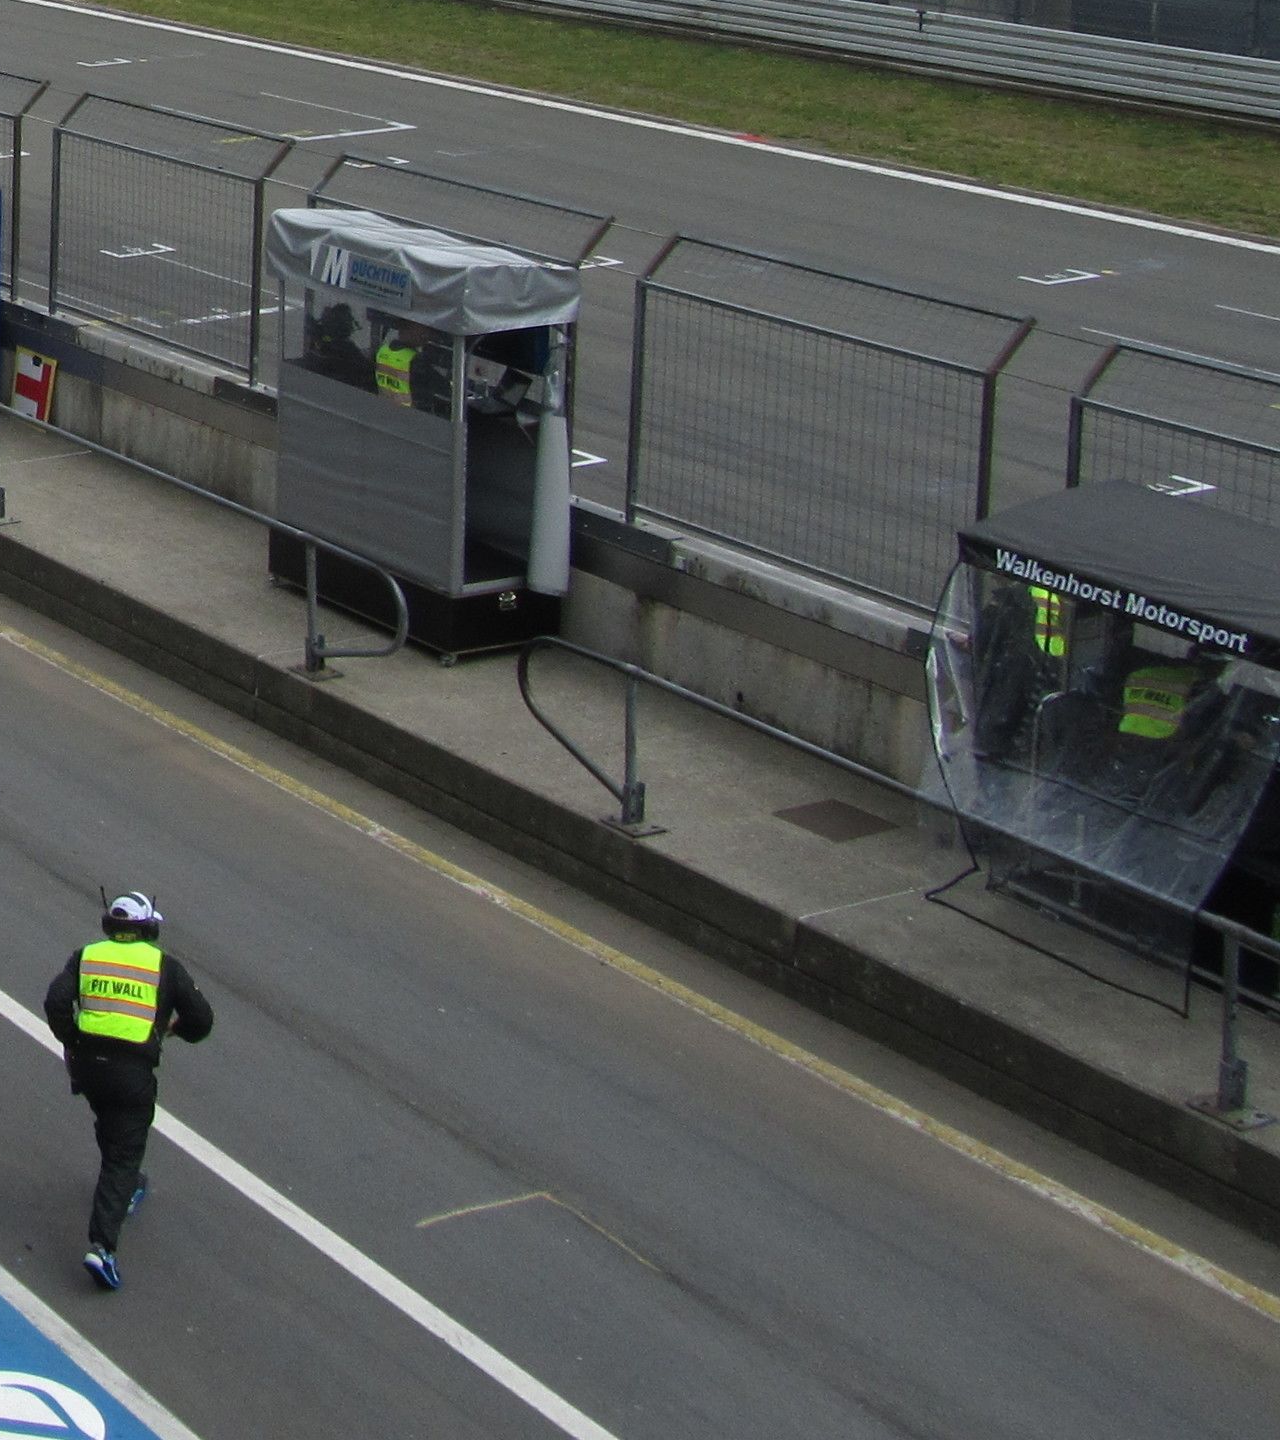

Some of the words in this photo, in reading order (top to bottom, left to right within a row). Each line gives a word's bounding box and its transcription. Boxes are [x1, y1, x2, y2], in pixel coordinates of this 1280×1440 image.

[996, 548, 1124, 610] Walkenhorst
[1125, 592, 1250, 653] Motorsport
[91, 979, 110, 994] PIT
[112, 981, 143, 999] WALL
